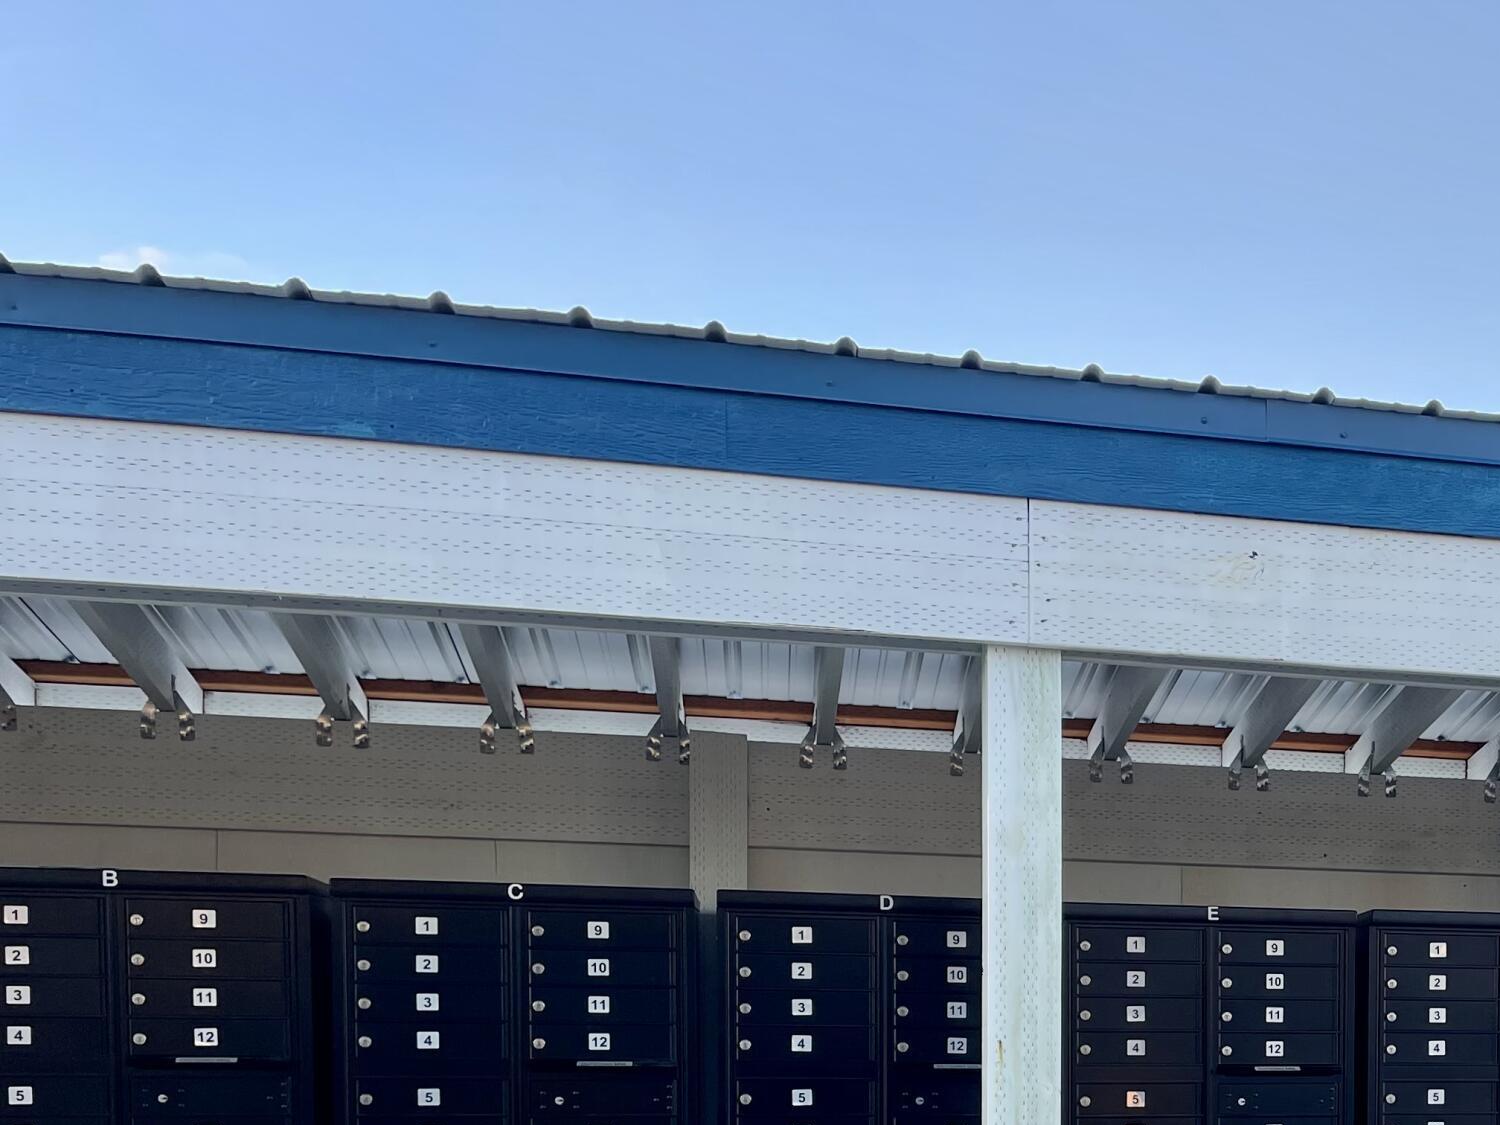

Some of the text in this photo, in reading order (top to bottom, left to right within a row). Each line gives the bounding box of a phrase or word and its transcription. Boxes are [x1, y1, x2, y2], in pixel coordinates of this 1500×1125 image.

[102, 869, 119, 887] B
[507, 883, 524, 900] C
[879, 894, 894, 911] D
[199, 913, 209, 925] 9
[1207, 906, 1220, 921] E
[594, 924, 603, 936] 9
[952, 934, 960, 945] 9
[11, 949, 22, 962] 2
[195, 952, 213, 964] 10
[423, 958, 432, 970] 2
[590, 962, 607, 974] 10
[797, 965, 805, 977] 2
[950, 969, 964, 981] 10
[1268, 976, 1281, 987] 10
[13, 989, 23, 1001] 3
[195, 991, 214, 1003] 11
[423, 996, 432, 1008] 3
[590, 999, 606, 1011] 11
[797, 1002, 806, 1013] 3
[950, 1005, 963, 1016] 11
[1268, 1010, 1280, 1020] 11
[13, 1029, 24, 1042] 4
[196, 1031, 215, 1043] 12
[423, 1035, 433, 1046] 4
[591, 1036, 608, 1048] 12
[797, 1038, 806, 1049] 4
[950, 1040, 964, 1051] 12
[1268, 1044, 1281, 1054] 12
[15, 1090, 25, 1102] 5
[425, 1092, 434, 1103] 5
[798, 1092, 806, 1103] 5
